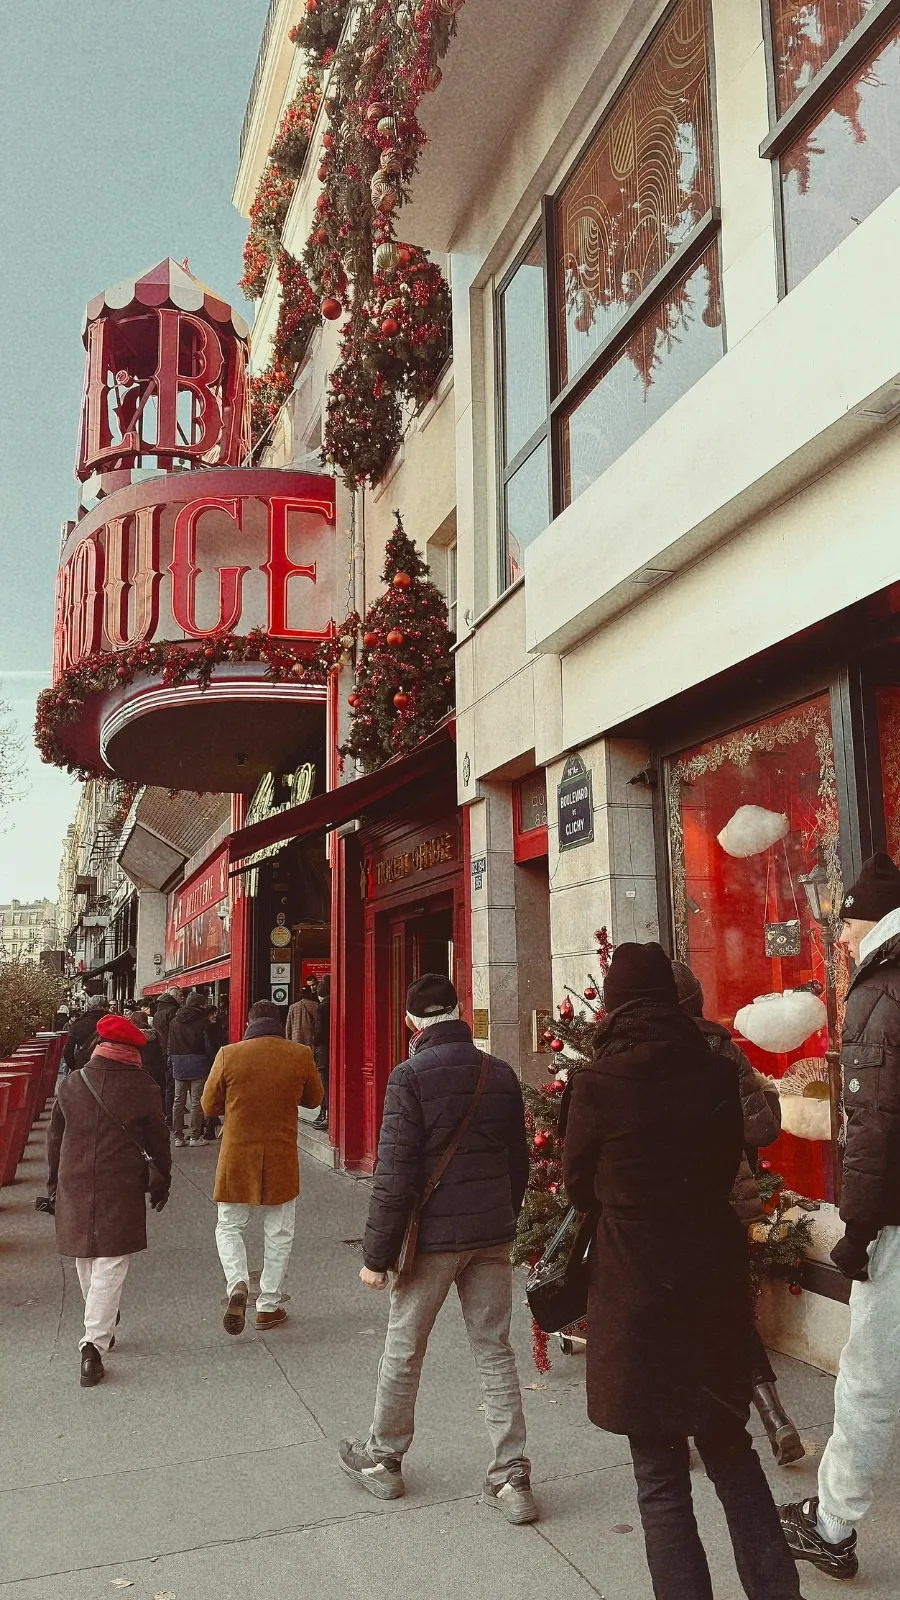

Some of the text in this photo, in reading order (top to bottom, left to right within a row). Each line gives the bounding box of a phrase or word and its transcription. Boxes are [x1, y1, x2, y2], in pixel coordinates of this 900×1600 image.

[560, 786, 589, 809] BOULEVARD
[565, 817, 585, 836] CLICHY
[376, 832, 453, 885] TICKET OFFICE
